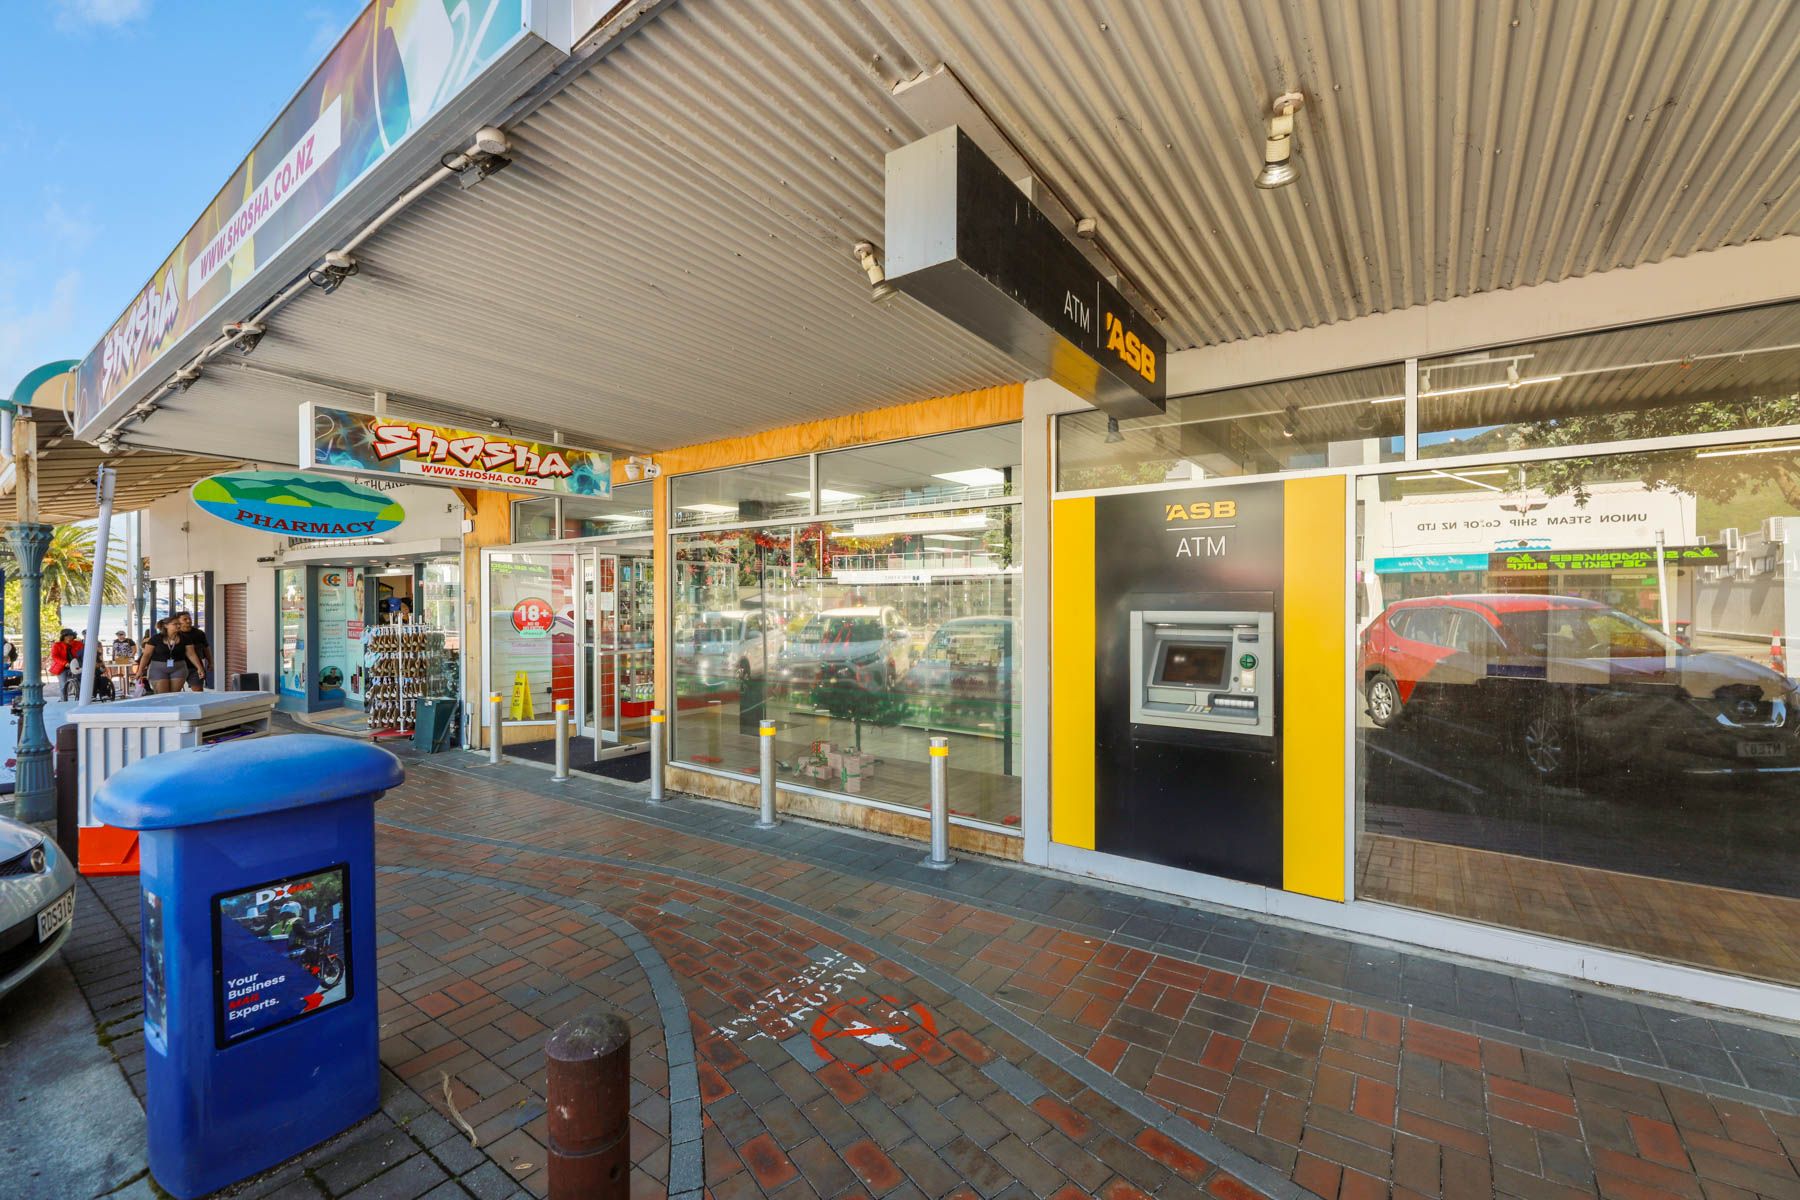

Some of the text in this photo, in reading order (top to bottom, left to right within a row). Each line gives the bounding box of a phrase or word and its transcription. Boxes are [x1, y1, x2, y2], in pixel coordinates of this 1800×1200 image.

[200, 133, 316, 280] WWW.SHOSHA.CO.NZ
[1064, 290, 1090, 334] ATM
[421, 464, 538, 487] WWW.SHOSHA.CO.NZ
[235, 509, 376, 534] PHARMACY
[1175, 535, 1226, 558] ATM
[518, 604, 549, 622] 18+
[227, 972, 259, 989] Your
[228, 974, 286, 1000] Business
[228, 997, 280, 1021] Experts.
